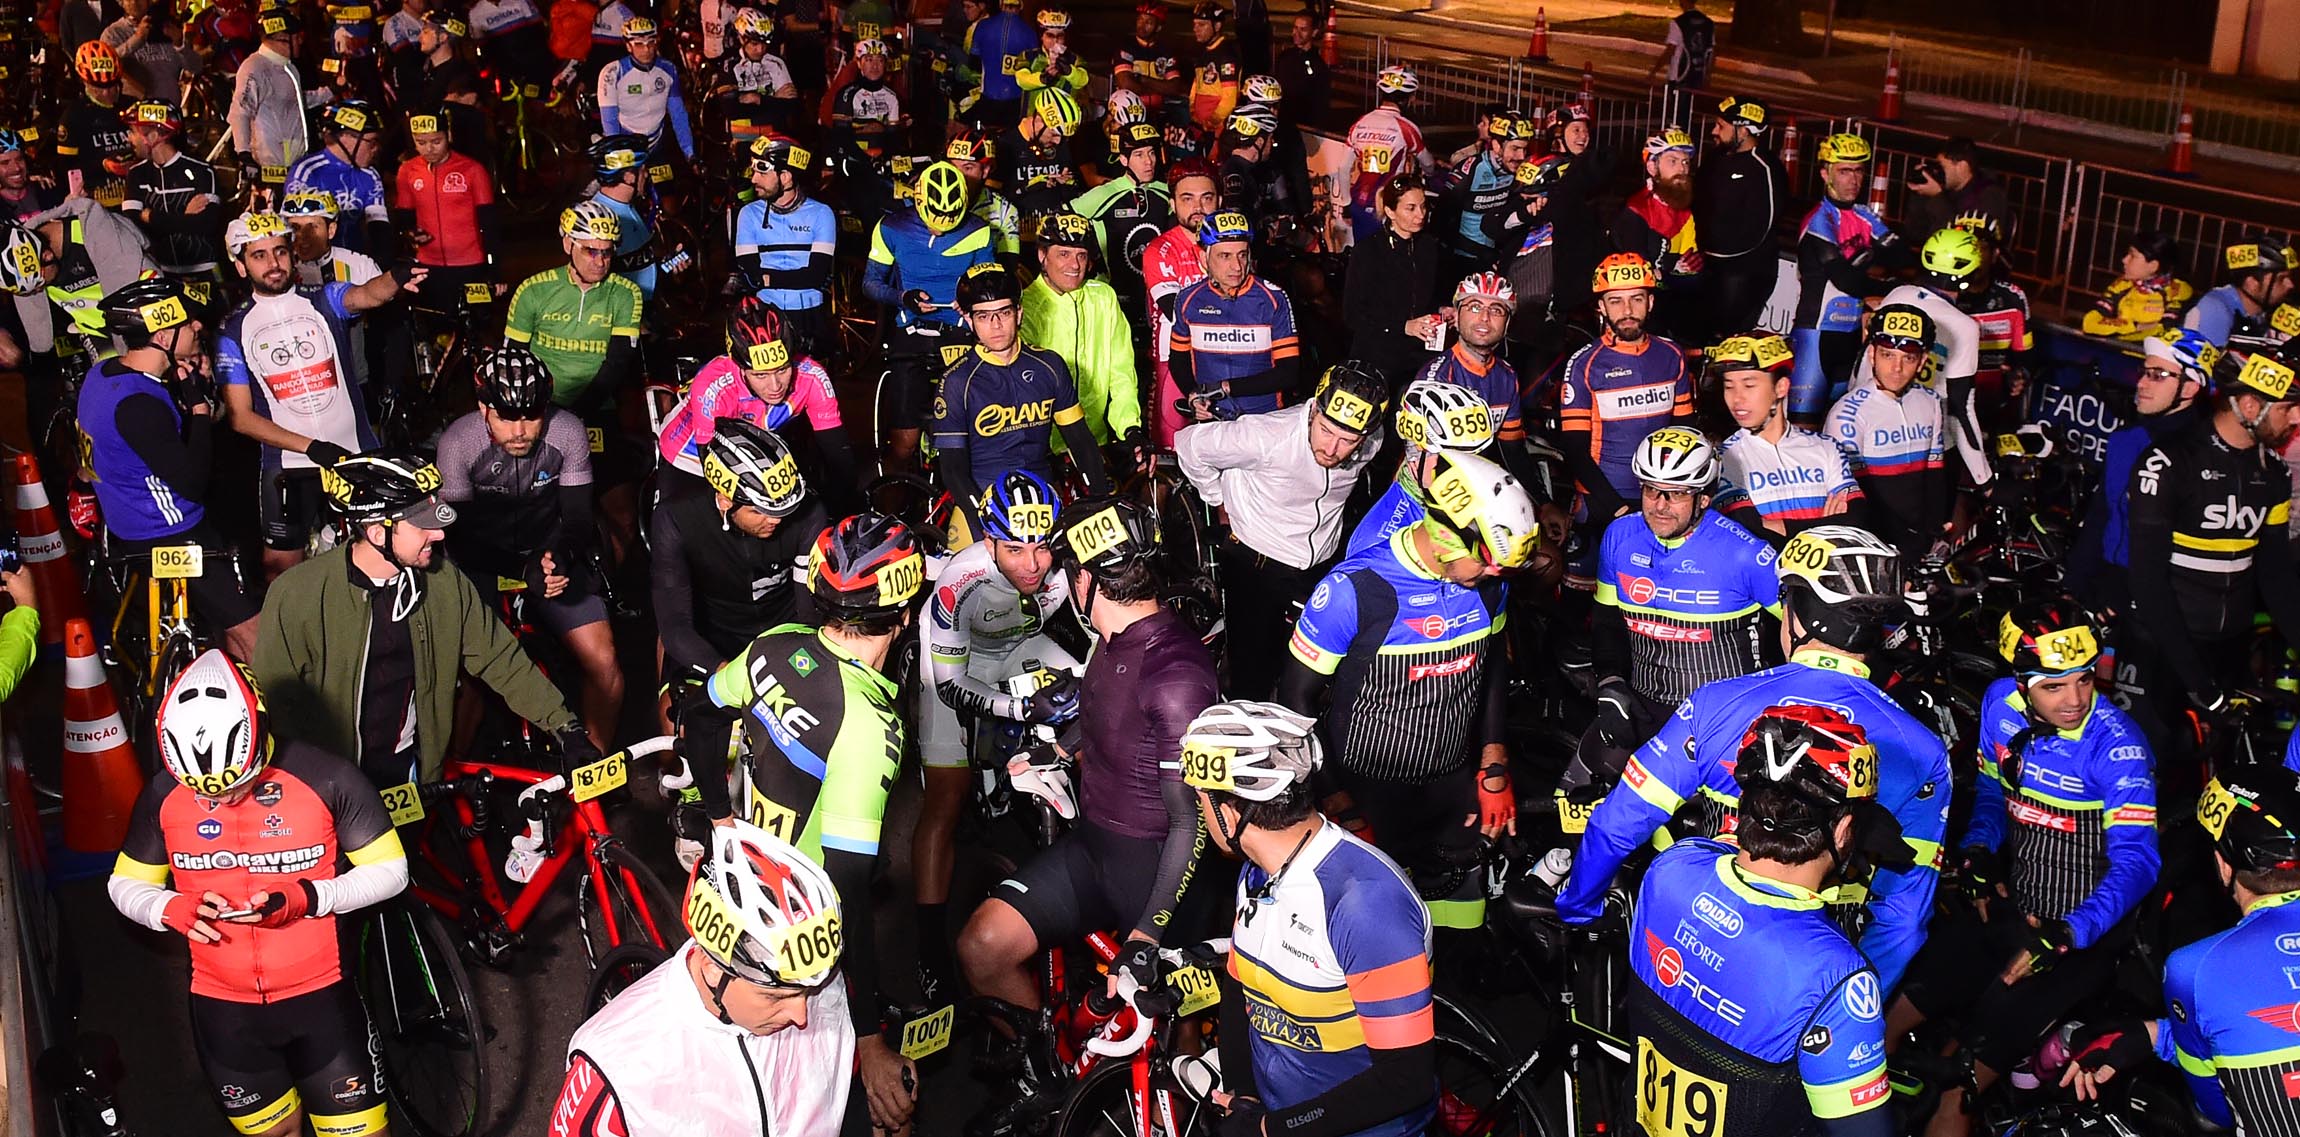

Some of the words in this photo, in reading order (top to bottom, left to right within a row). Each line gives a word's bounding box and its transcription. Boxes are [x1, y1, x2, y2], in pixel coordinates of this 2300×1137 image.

[339, 111, 364, 128] 757
[412, 117, 437, 131] 940
[1134, 125, 1158, 138] 750
[1236, 118, 1259, 135] 107
[248, 214, 279, 231] 837
[1060, 216, 1088, 232] 965
[1218, 215, 1246, 228] 809
[15, 244, 37, 275] 835
[64, 275, 99, 293] DIARIES
[1611, 267, 1642, 282] 798
[152, 304, 178, 326] 962
[1887, 316, 1920, 332] 828
[1203, 329, 1257, 344] medici
[753, 346, 787, 367] 1035
[2250, 360, 2288, 391] 1056
[1331, 396, 1367, 425] 954
[1617, 388, 1672, 408] medici
[1399, 417, 1424, 442] 859
[1450, 412, 1489, 438] 859
[1874, 423, 1935, 447] Deluka
[1654, 430, 1692, 449] 923
[705, 460, 733, 493] 884
[767, 461, 798, 492] 884
[1749, 465, 1826, 491] Deluka
[2137, 447, 2172, 497] sky
[1440, 479, 1471, 513] 979
[2200, 494, 2268, 538] sky
[1075, 517, 1116, 554] 1019
[1715, 516, 1756, 546] LEFORTE
[160, 549, 193, 567] 962
[1785, 537, 1824, 570] 890
[885, 561, 919, 599] 1001
[1631, 580, 1721, 606] RACE
[1425, 609, 1482, 638] RACE
[1625, 618, 1703, 641] TREK
[1747, 612, 1762, 670] TREK
[1412, 656, 1475, 679] TREK
[65, 725, 118, 743] ATENÇÃO
[236, 706, 250, 767] S-WORKS
[756, 703, 795, 748] BIKES
[582, 758, 618, 788] 876
[1183, 750, 1227, 783] 899
[1853, 755, 1876, 788] 81
[2022, 760, 2085, 794] ACE
[184, 766, 242, 796] 860
[2229, 783, 2260, 801] Tinkoff
[2007, 800, 2068, 831] REK
[198, 823, 221, 835] GU
[285, 859, 320, 874] SHOP
[689, 892, 732, 955] 1066
[780, 917, 840, 972] 1066
[1280, 939, 1316, 965] ZANINOTTO
[1673, 924, 1726, 973] LEFORTE
[1172, 967, 1213, 996] 1019
[1657, 953, 1746, 1027] RACE
[1803, 1031, 1828, 1047] GU
[1643, 1049, 1719, 1137] 819
